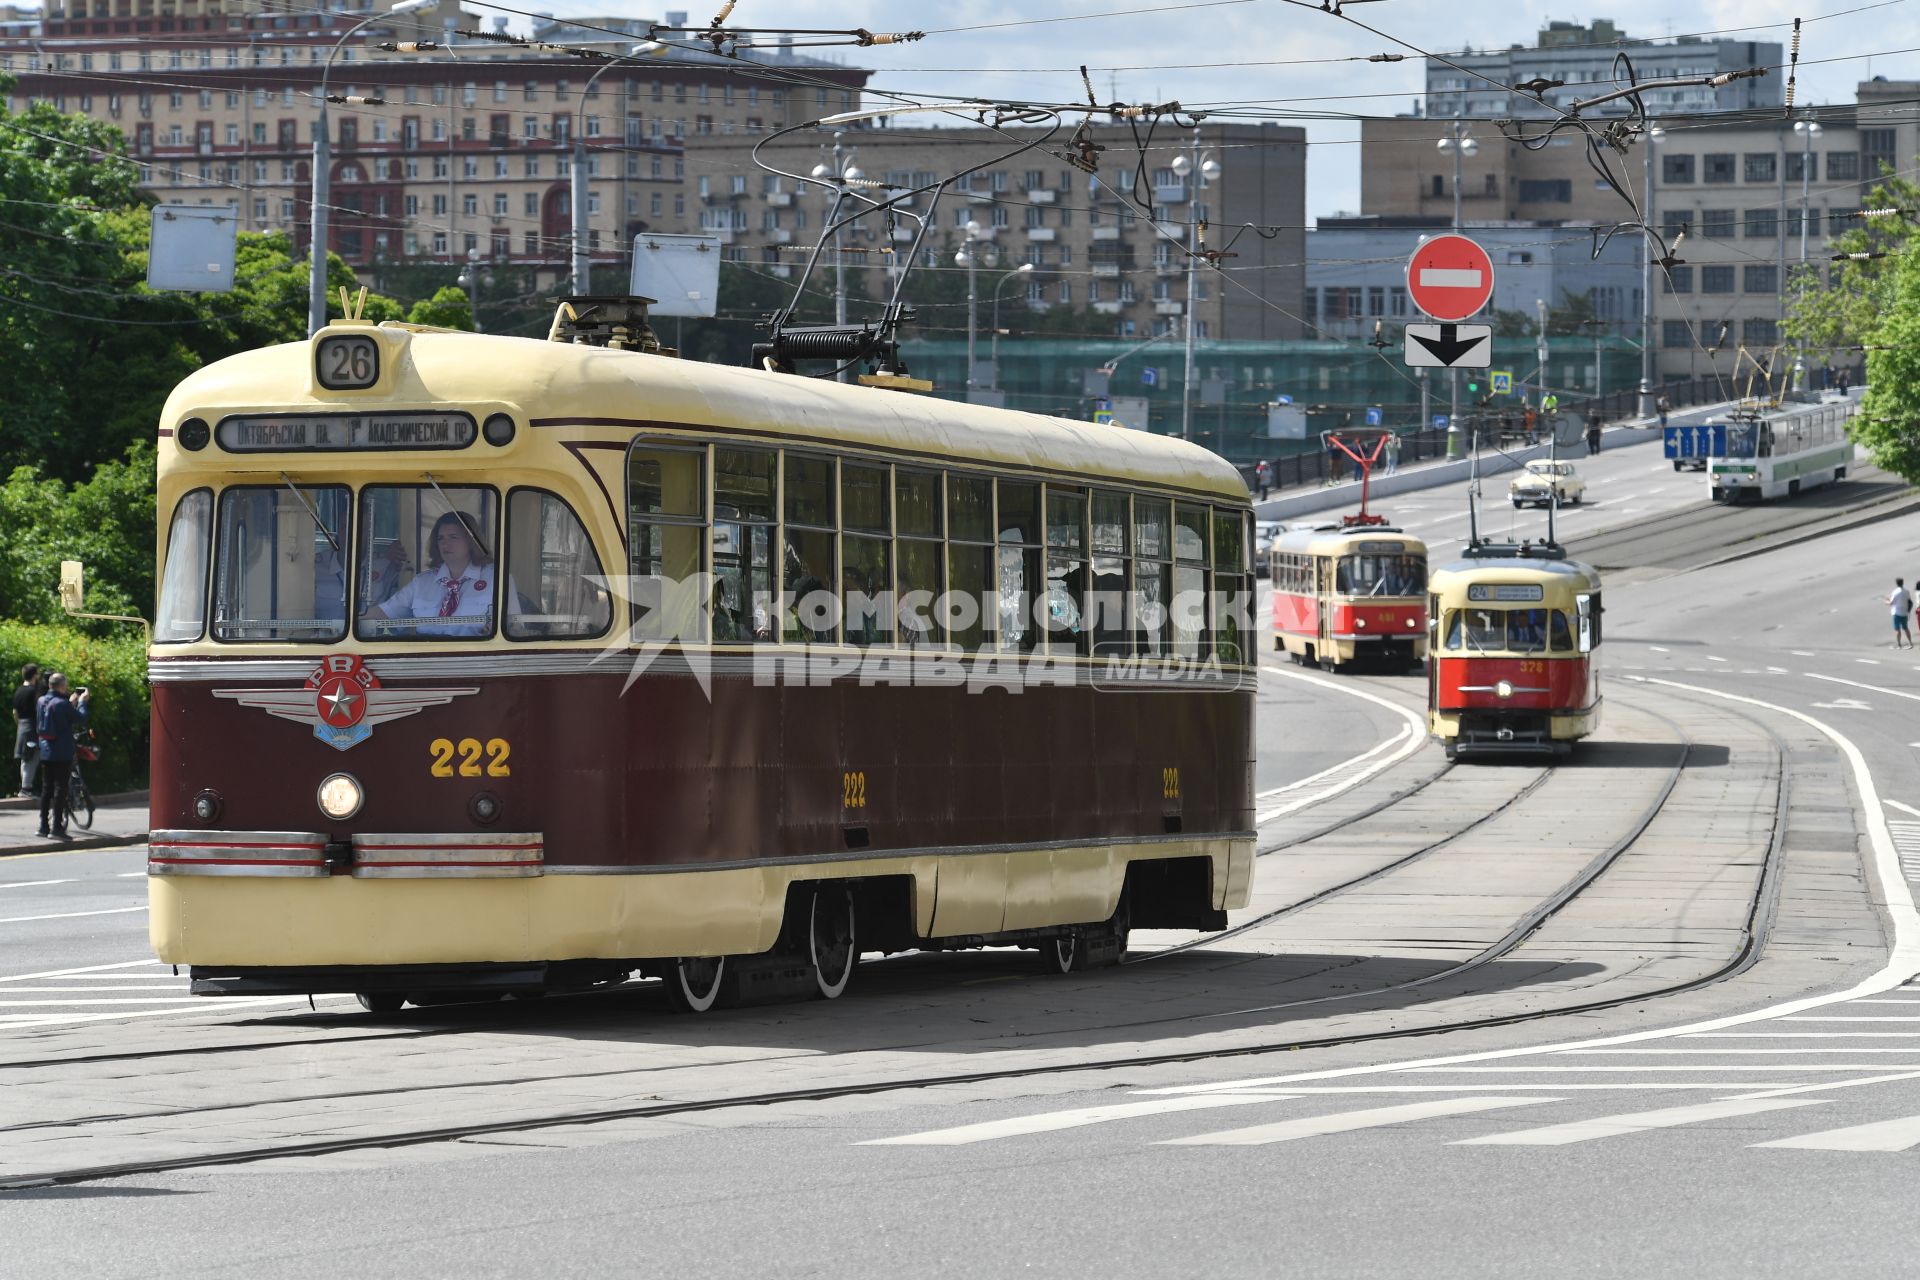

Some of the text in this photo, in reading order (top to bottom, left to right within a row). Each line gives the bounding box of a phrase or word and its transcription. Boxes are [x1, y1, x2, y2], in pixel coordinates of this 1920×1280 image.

[331, 345, 371, 380] 26
[237, 421, 306, 445] ОКТЯБРЬСКАЯ
[368, 418, 449, 444] АКАДЕМИЧЕСКИЙ
[1471, 586, 1486, 599] 24
[309, 656, 373, 687] РВЗ
[1520, 660, 1543, 673] 378
[429, 737, 511, 778] 222
[843, 771, 866, 809] 222
[1163, 767, 1179, 799] 222
